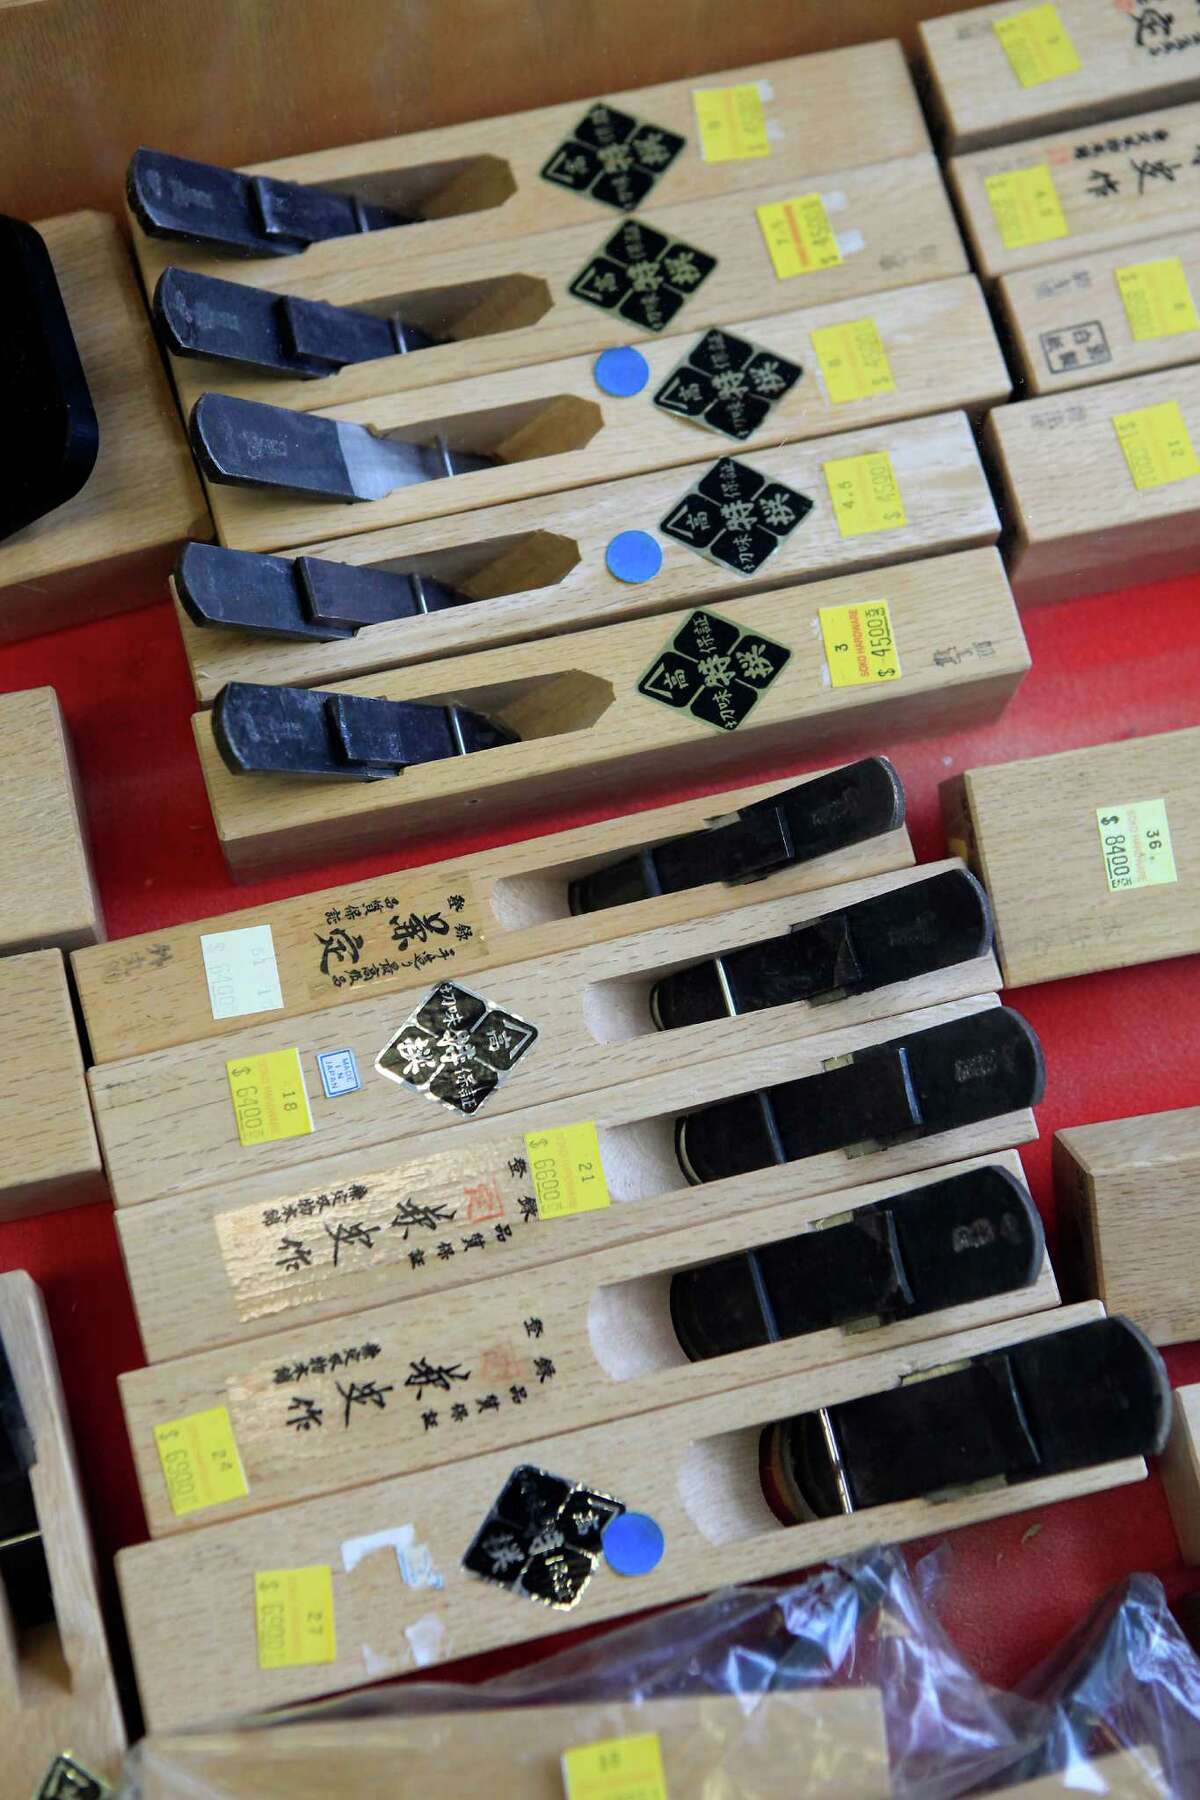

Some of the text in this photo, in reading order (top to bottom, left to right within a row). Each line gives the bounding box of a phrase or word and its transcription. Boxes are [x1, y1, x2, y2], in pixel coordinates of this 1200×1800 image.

[693, 615, 718, 655] 保証
[845, 606, 866, 654] HARDWARE
[833, 642, 849, 653] 3
[876, 666, 896, 678] $
[712, 690, 736, 730] 切味
[1099, 814, 1119, 827] $
[230, 1065, 252, 1079] $
[324, 1059, 338, 1090] JAPAN
[340, 1056, 354, 1083] MADE
[280, 1089, 299, 1112] 18
[528, 1137, 549, 1149] $
[577, 1161, 595, 1183] 21
